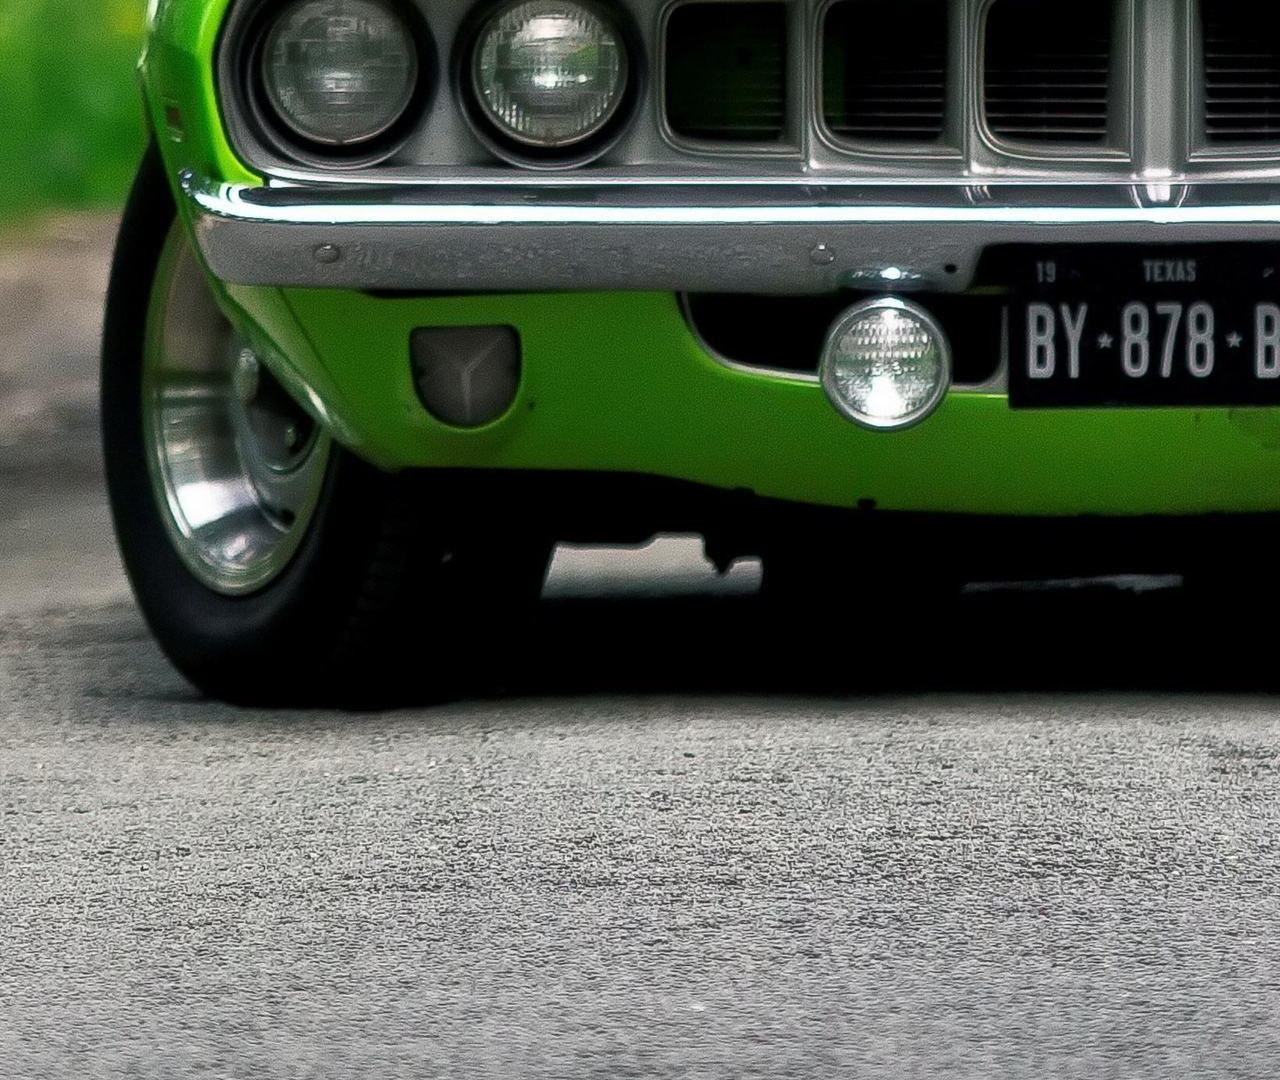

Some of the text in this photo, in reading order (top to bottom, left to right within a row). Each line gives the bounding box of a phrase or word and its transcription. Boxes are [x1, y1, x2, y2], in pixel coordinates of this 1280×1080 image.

[1035, 260, 1057, 284] 19
[1142, 259, 1197, 283] TEXAS
[1026, 301, 1088, 379] BY
[1120, 301, 1216, 379] 878
